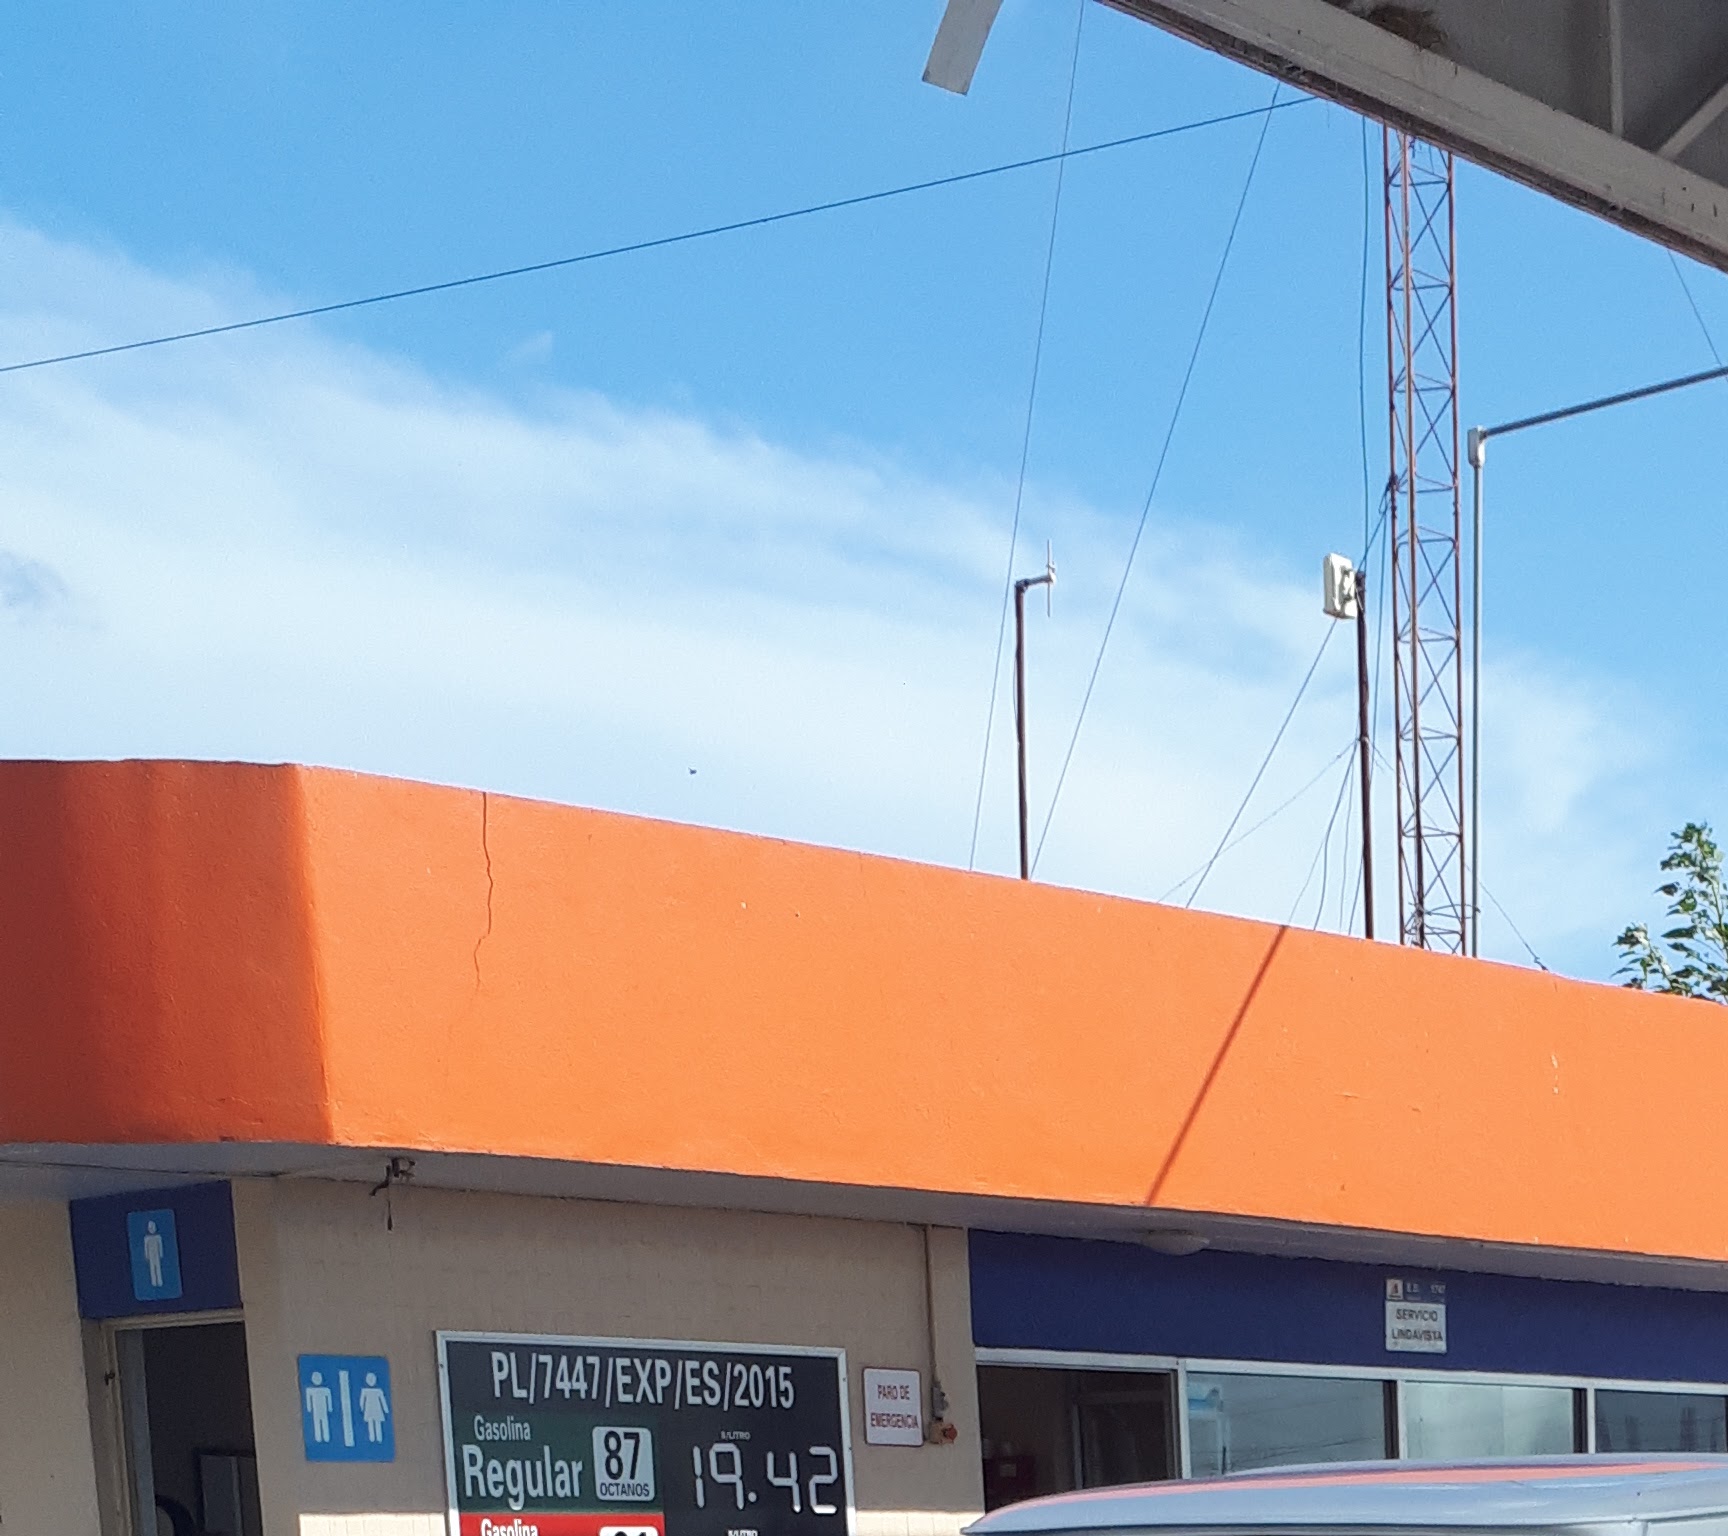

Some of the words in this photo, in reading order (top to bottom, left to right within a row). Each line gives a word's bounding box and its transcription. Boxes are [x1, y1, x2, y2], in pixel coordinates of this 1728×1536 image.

[1396, 1308, 1438, 1322] SERVICIO
[1391, 1328, 1443, 1341] LINDAVISTA
[491, 1351, 796, 1412] PL/7447/EXP/ES/2015
[877, 1384, 898, 1400] PARO
[900, 1384, 910, 1400] DE
[473, 1415, 531, 1441] Gasolina
[870, 1412, 919, 1429] EMERGENCIA
[603, 1430, 641, 1480] 87
[462, 1444, 583, 1511] Regular
[692, 1443, 838, 1514] 19.42
[600, 1482, 650, 1497] OCTANOS
